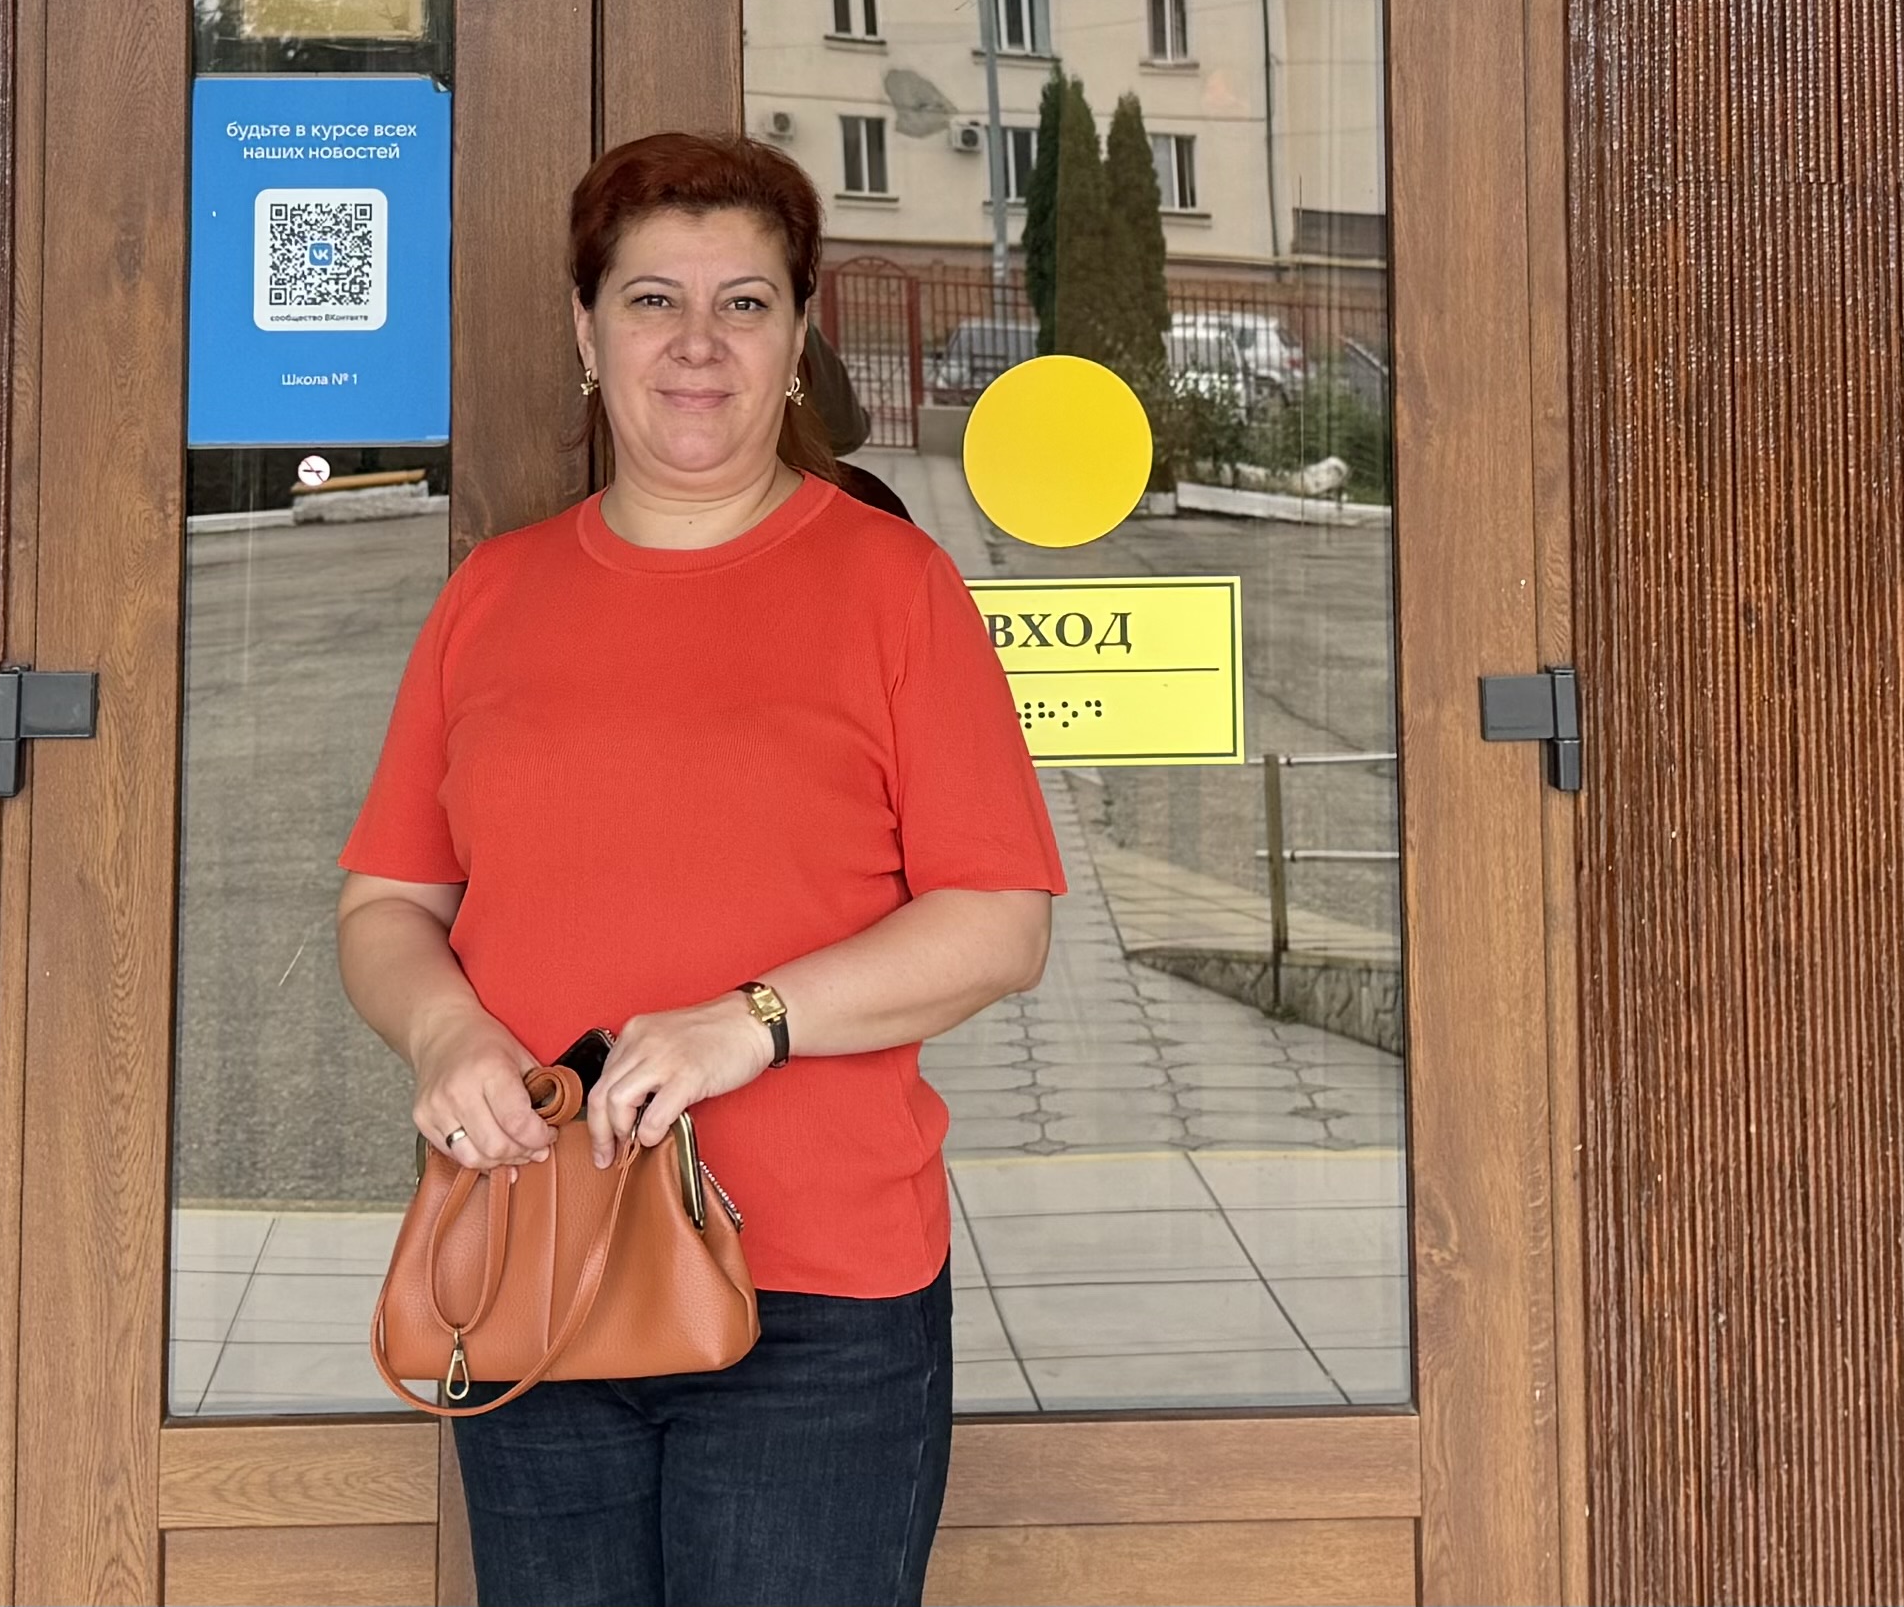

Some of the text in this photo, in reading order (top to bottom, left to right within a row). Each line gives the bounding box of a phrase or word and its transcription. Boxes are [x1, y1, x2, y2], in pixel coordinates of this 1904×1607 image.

[226, 122, 417, 141] будьте в курсе всех
[243, 143, 400, 159] наших новостей
[270, 314, 323, 322] сообщество
[282, 373, 358, 386] Школа № 1
[984, 612, 1132, 655] ВХОД
